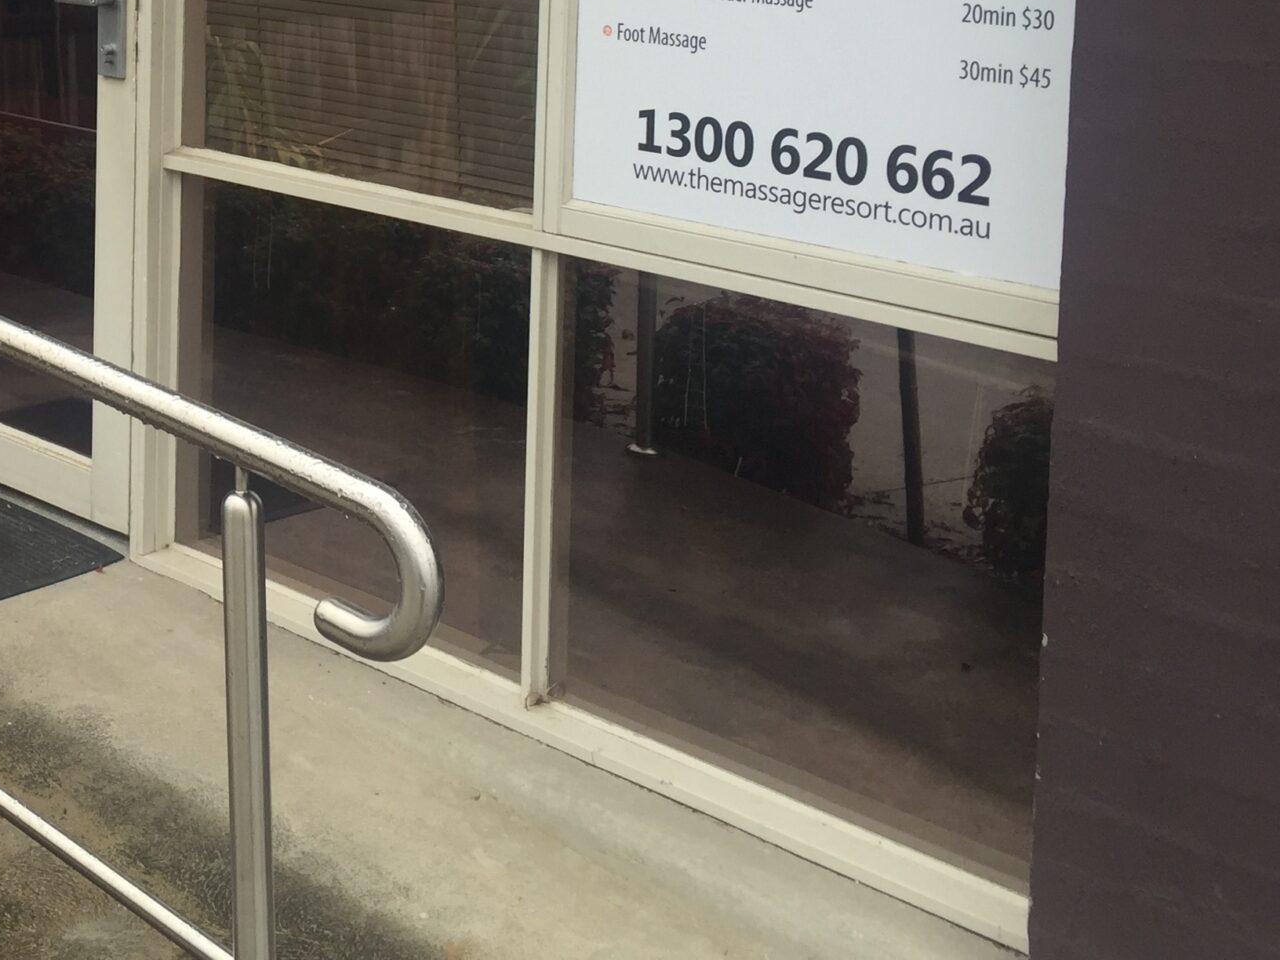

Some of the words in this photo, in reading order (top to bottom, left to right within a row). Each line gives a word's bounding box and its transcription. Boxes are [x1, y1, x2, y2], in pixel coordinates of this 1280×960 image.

[962, 3, 1016, 27] 20min
[1022, 6, 1054, 30] $30
[617, 23, 645, 43] Foot
[648, 26, 706, 54] Massage
[959, 60, 1013, 85] 30min
[1019, 64, 1051, 88] $45
[636, 109, 754, 170] 1300
[770, 128, 868, 188] 620
[884, 145, 991, 209] 662
[633, 161, 991, 239] www.themassageresort.com.au
